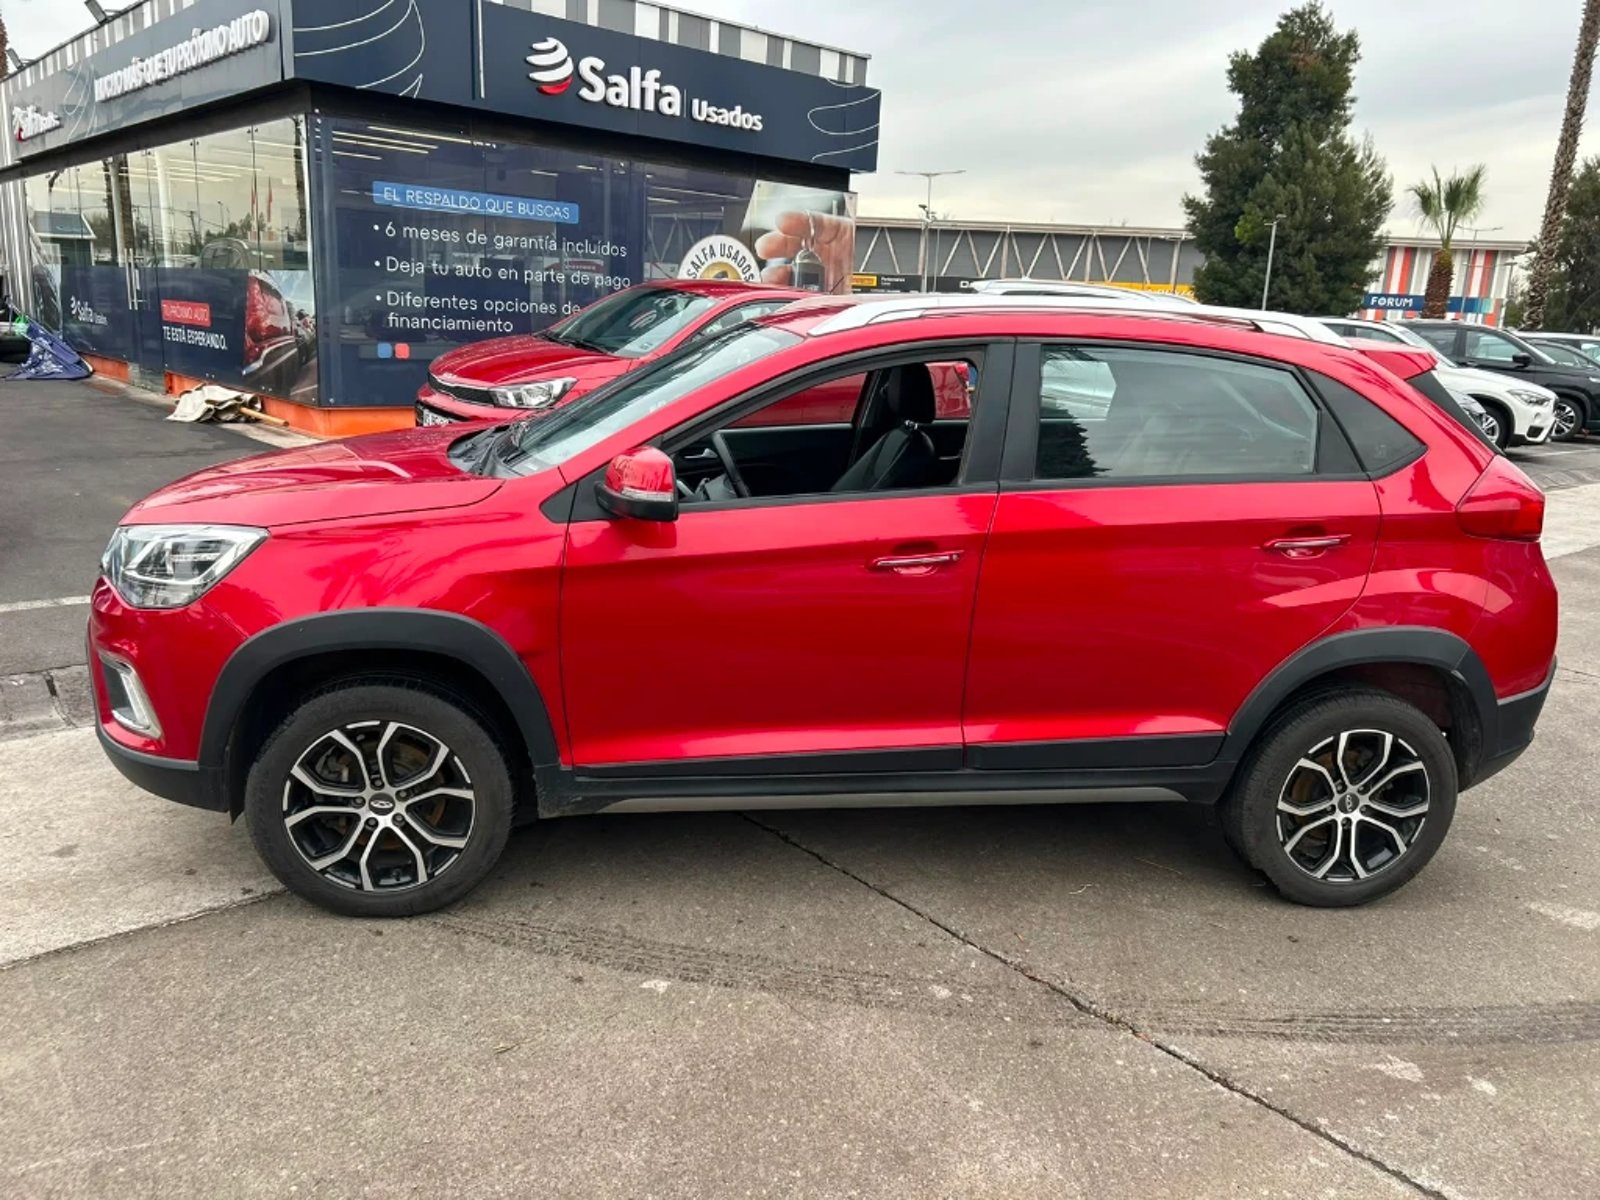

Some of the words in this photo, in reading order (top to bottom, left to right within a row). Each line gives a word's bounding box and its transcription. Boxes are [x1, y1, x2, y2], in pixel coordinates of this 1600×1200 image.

[228, 9, 270, 51] AUTO
[577, 56, 682, 117] Salfa
[691, 98, 764, 131] Usados
[383, 187, 401, 202] EL
[406, 189, 481, 210] RESPALDO
[485, 199, 514, 214] QUE
[518, 203, 570, 220] BUSCAS
[385, 222, 396, 238] 6
[402, 225, 460, 243] meses
[466, 228, 488, 245] de
[493, 233, 558, 252] garantía
[386, 256, 425, 278] Deja
[432, 262, 449, 276] tu
[455, 264, 493, 280] auto
[498, 268, 519, 282] en
[524, 268, 566, 285] parte
[571, 269, 590, 285] de
[594, 273, 631, 290] pago
[686, 244, 716, 279] SALFA
[719, 242, 755, 282] USADOS
[386, 290, 478, 312] Diferentes
[484, 298, 557, 316] opciones
[562, 301, 581, 315] de
[1370, 296, 1413, 307] FORUM
[162, 326, 171, 340] TE
[387, 311, 513, 333] financiamiento
